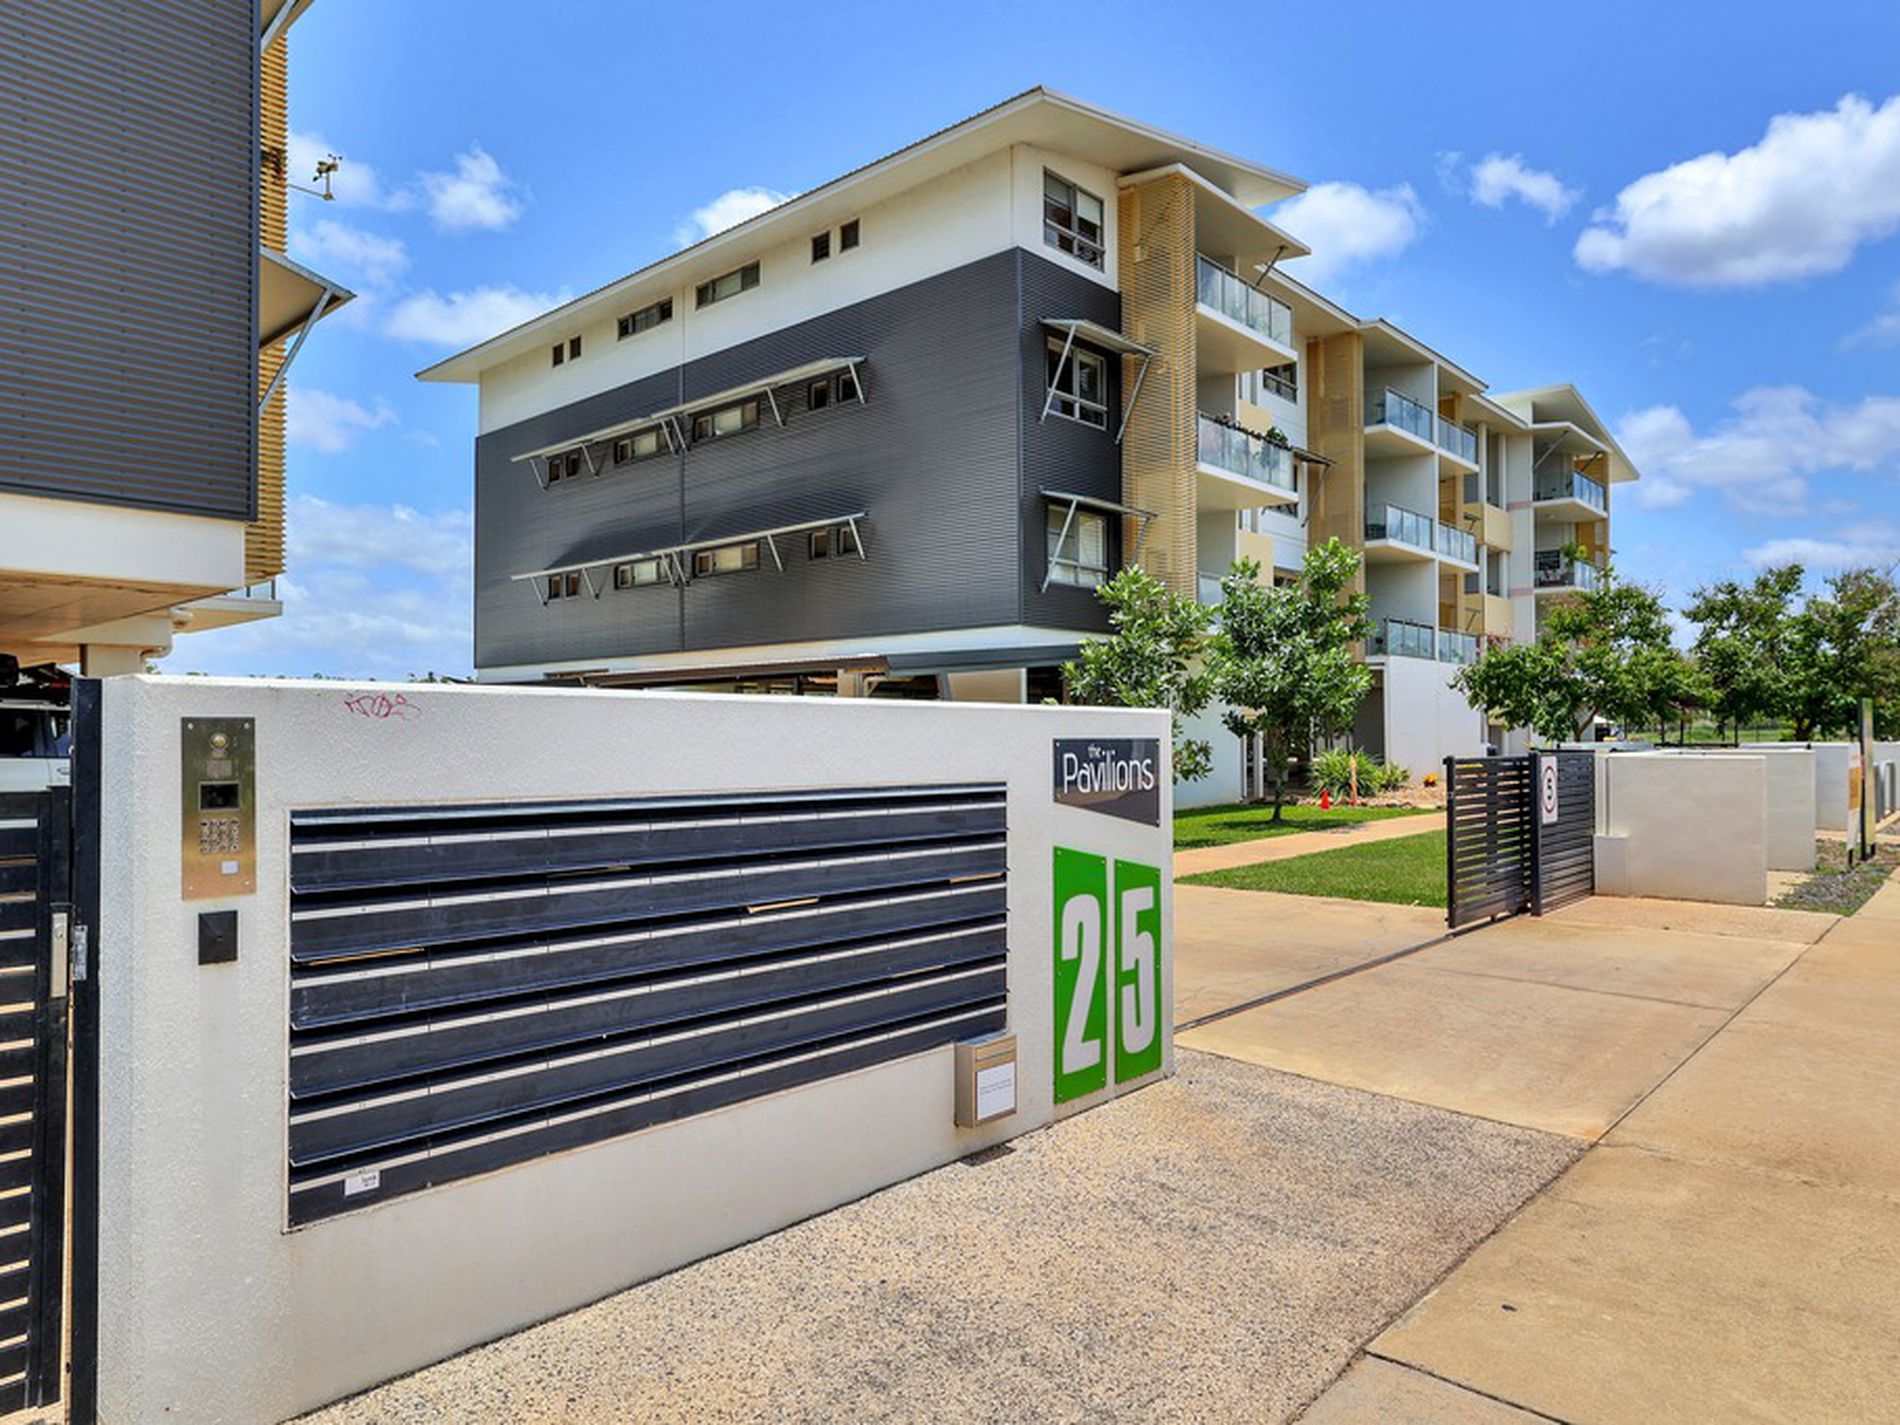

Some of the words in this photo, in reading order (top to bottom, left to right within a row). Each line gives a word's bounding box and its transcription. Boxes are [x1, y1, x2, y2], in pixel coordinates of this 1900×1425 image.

[1087, 743, 1101, 759] the
[1062, 749, 1155, 794] Pavilions
[1546, 777, 1554, 801] 5
[1061, 887, 1156, 1074] 25
